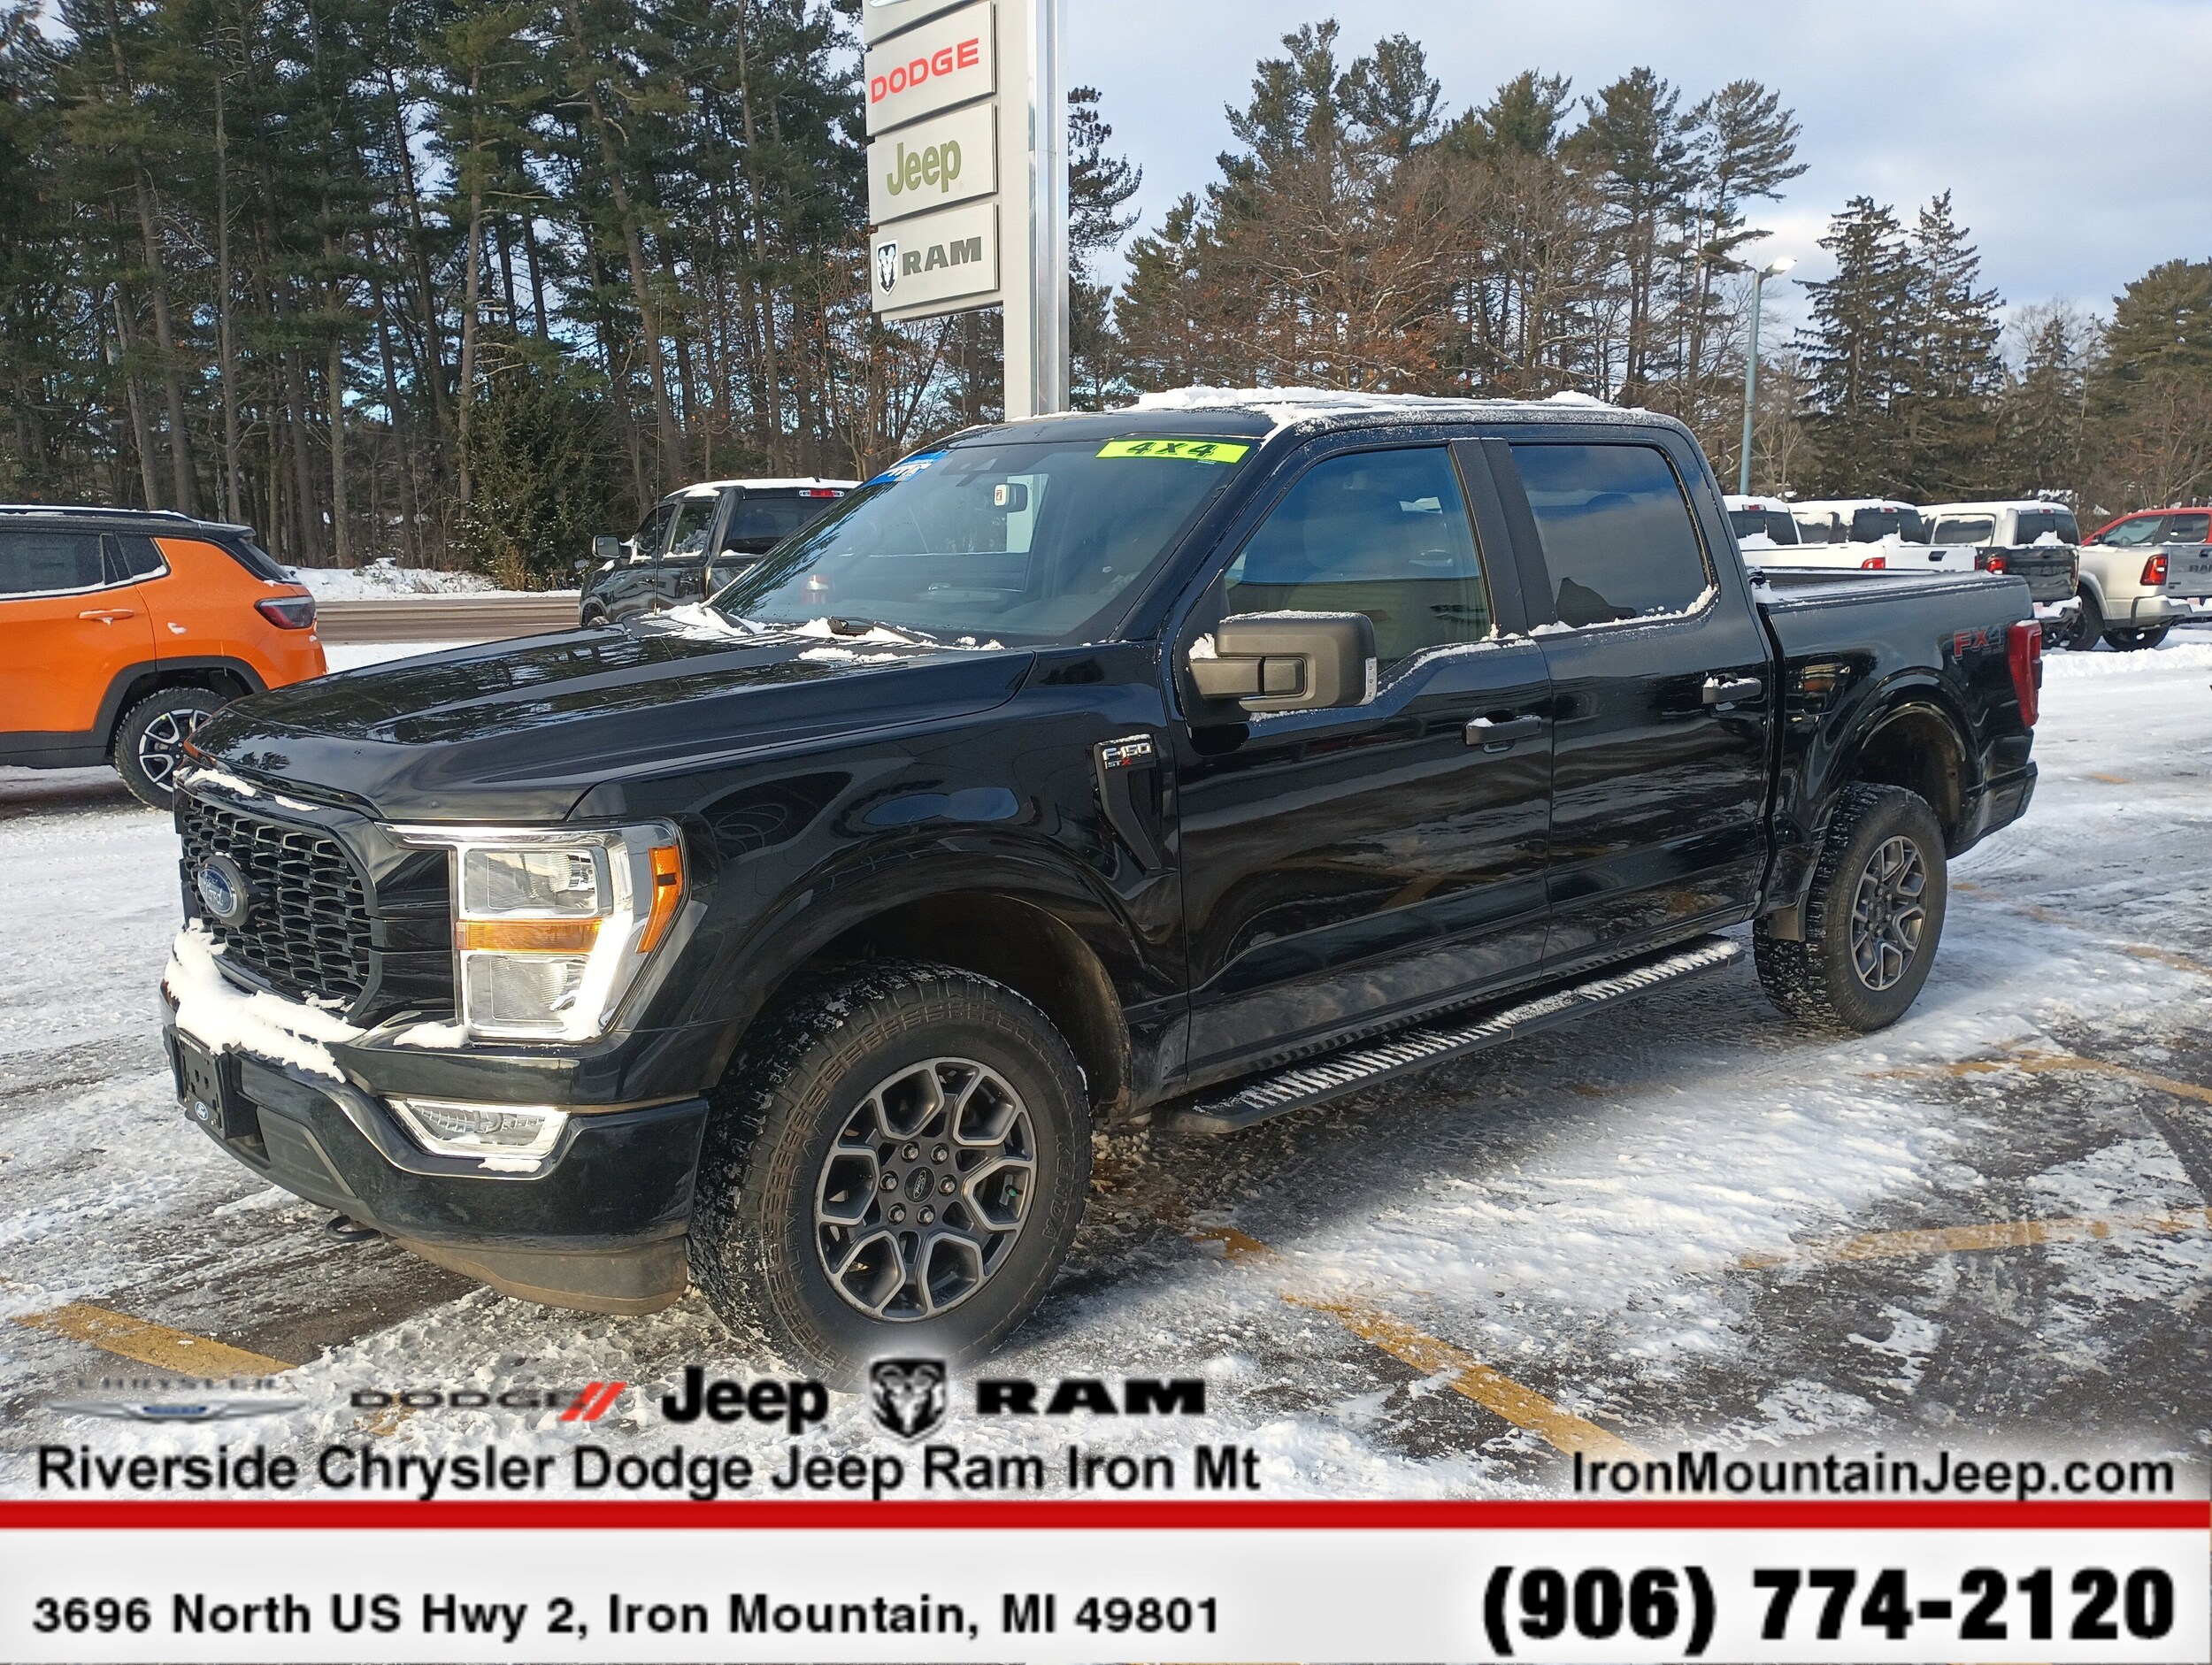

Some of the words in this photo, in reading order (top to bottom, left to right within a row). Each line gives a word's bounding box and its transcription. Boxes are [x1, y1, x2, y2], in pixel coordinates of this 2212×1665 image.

[871, 38, 979, 104] DODGE
[887, 140, 962, 196] Jeep
[902, 236, 982, 276] RAM
[1126, 441, 1218, 457] 4X4
[1954, 624, 2003, 660] FX4
[200, 871, 226, 907] Ford
